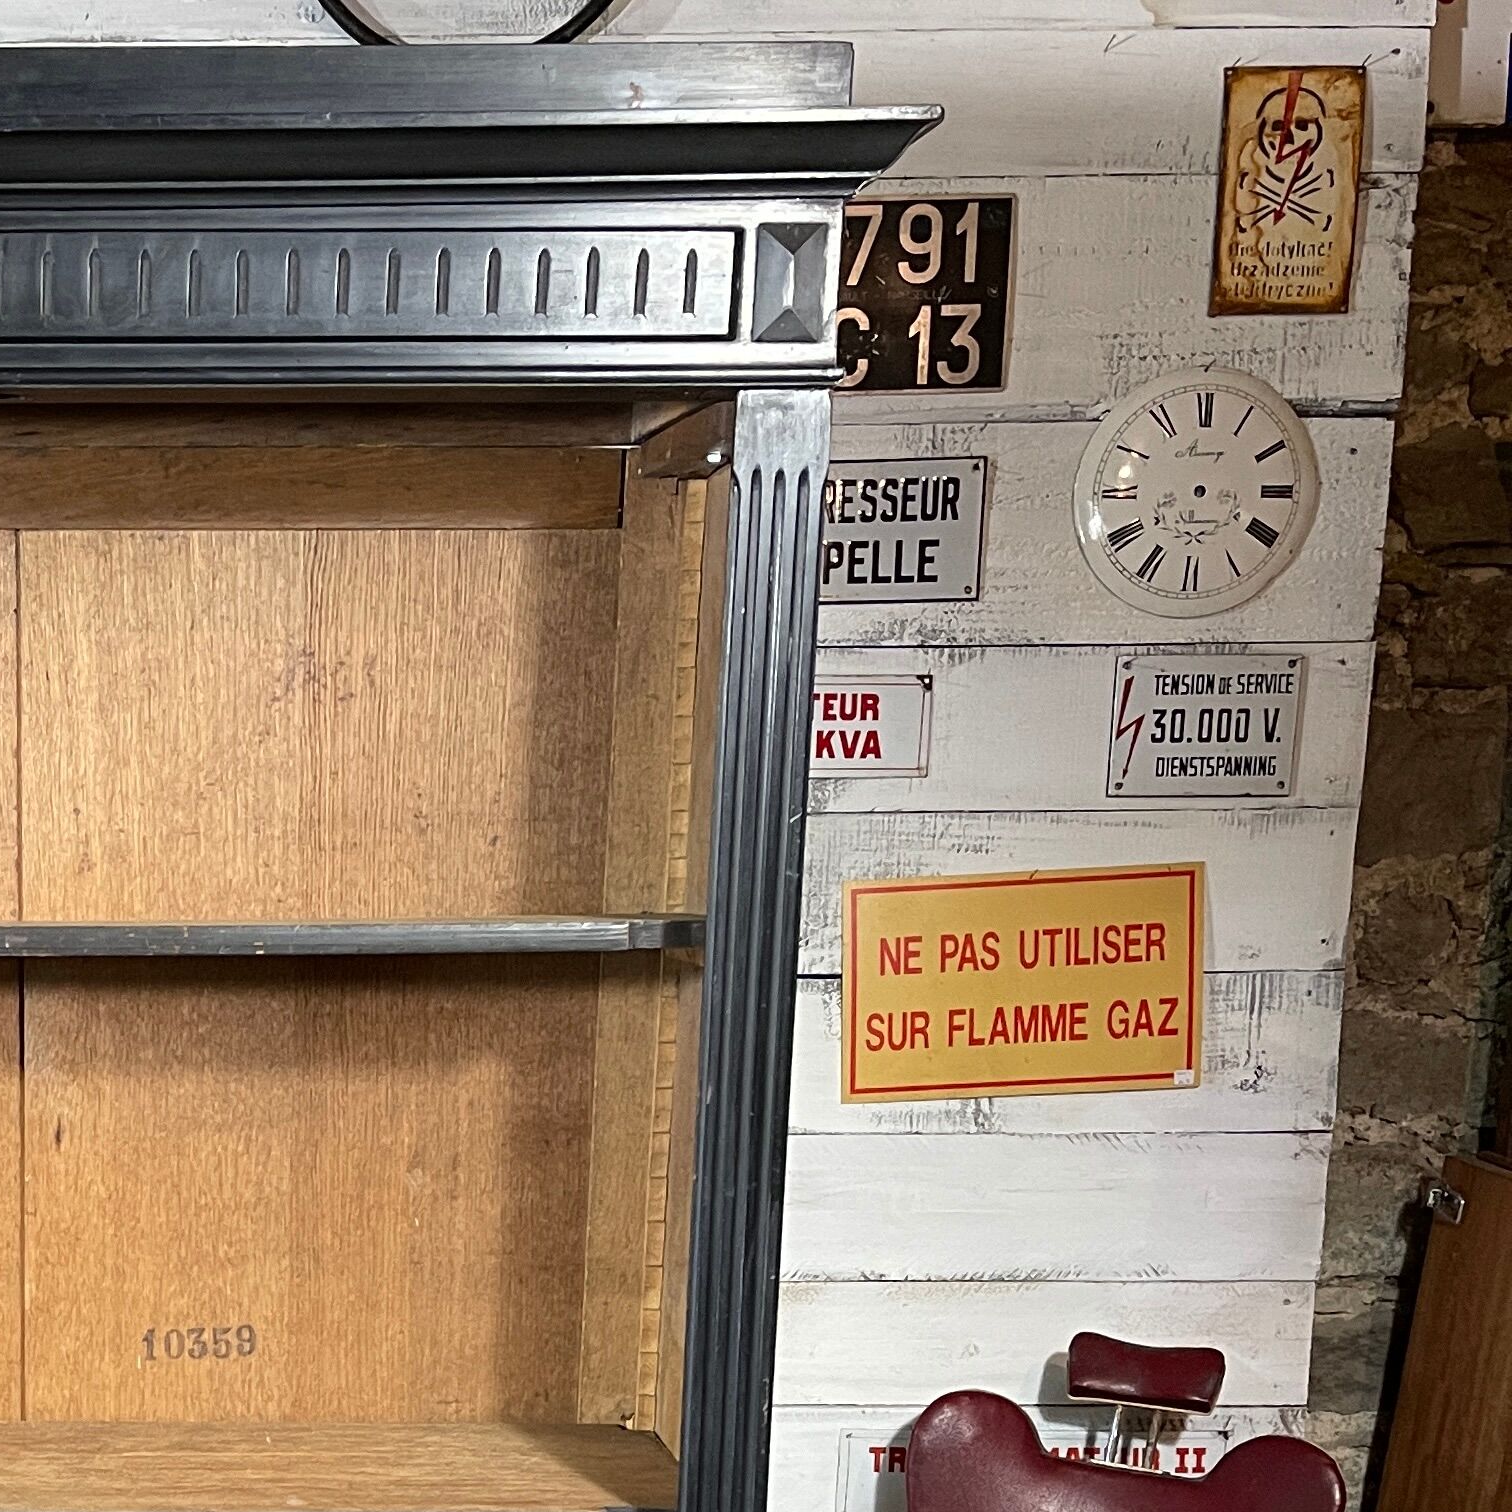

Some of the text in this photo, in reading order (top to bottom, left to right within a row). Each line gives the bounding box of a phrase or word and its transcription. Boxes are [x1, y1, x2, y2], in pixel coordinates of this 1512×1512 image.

[845, 202, 979, 286] 791
[908, 304, 982, 385] 13
[825, 477, 961, 524] RESSEUR
[822, 539, 940, 584] PELLE
[1155, 674, 1294, 696] TENSION DE SERVICE
[815, 730, 882, 759] KVA
[1150, 707, 1281, 743] 30.000 V.
[1155, 756, 1276, 777] DIENSTSPANNING
[879, 923, 1166, 976] NE PAS UTILISER
[865, 997, 1179, 1051] SUR FLAMME GAZ
[141, 1324, 257, 1361] 10359
